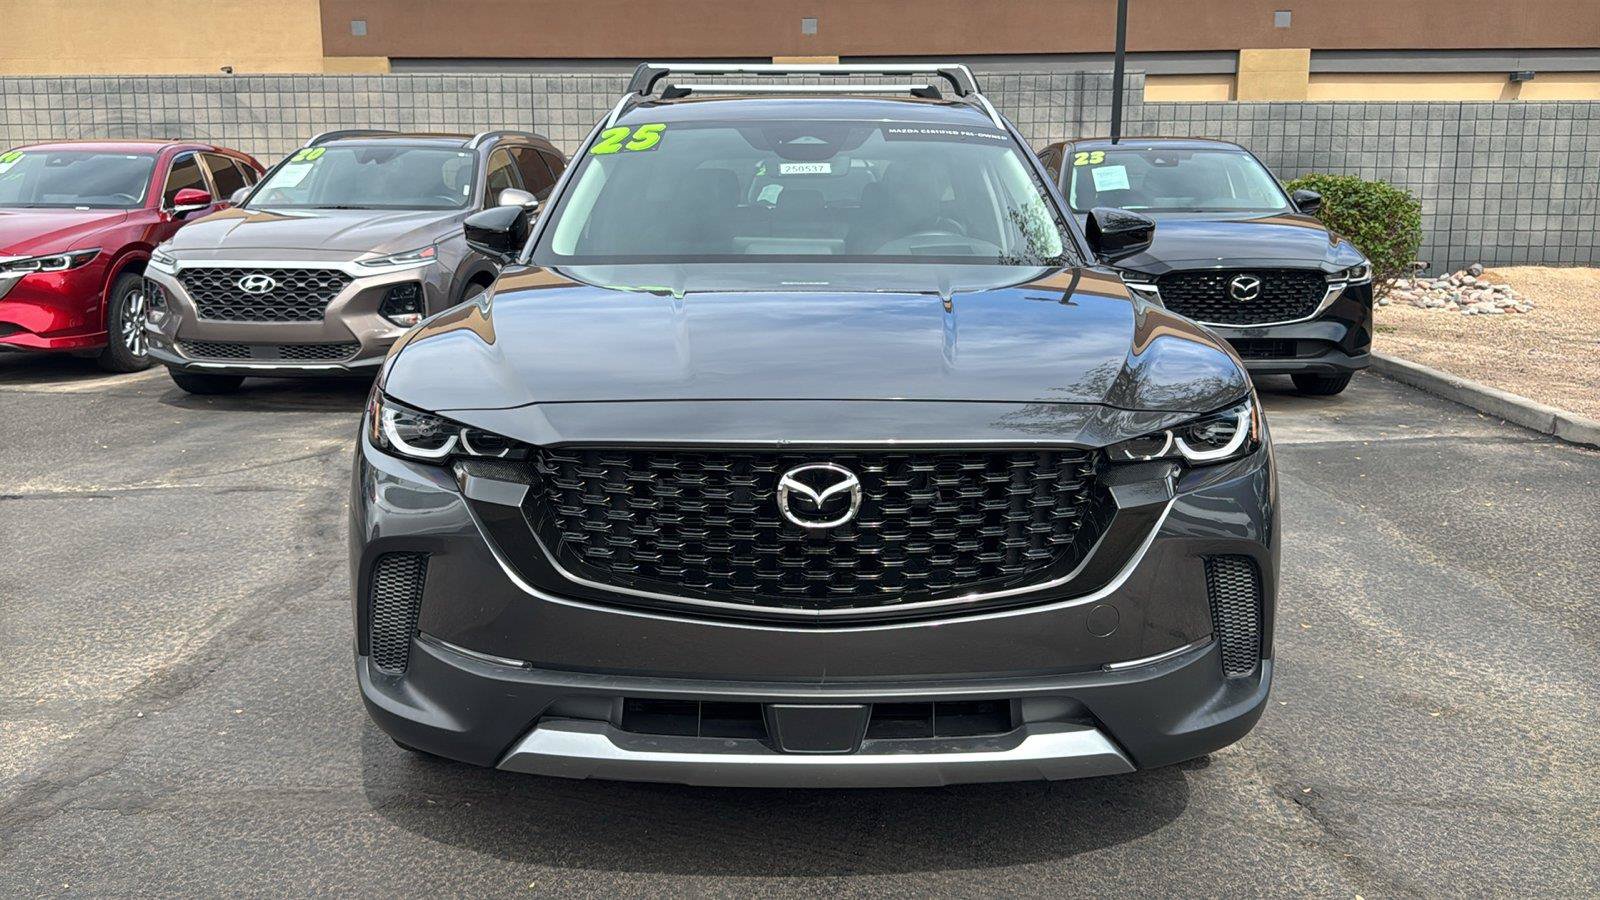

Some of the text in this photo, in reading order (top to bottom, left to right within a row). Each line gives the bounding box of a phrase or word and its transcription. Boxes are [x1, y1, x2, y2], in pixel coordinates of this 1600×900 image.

[590, 123, 667, 154] 25
[290, 147, 326, 162] 20
[1073, 151, 1105, 166] 23
[785, 165, 824, 173] 250537
